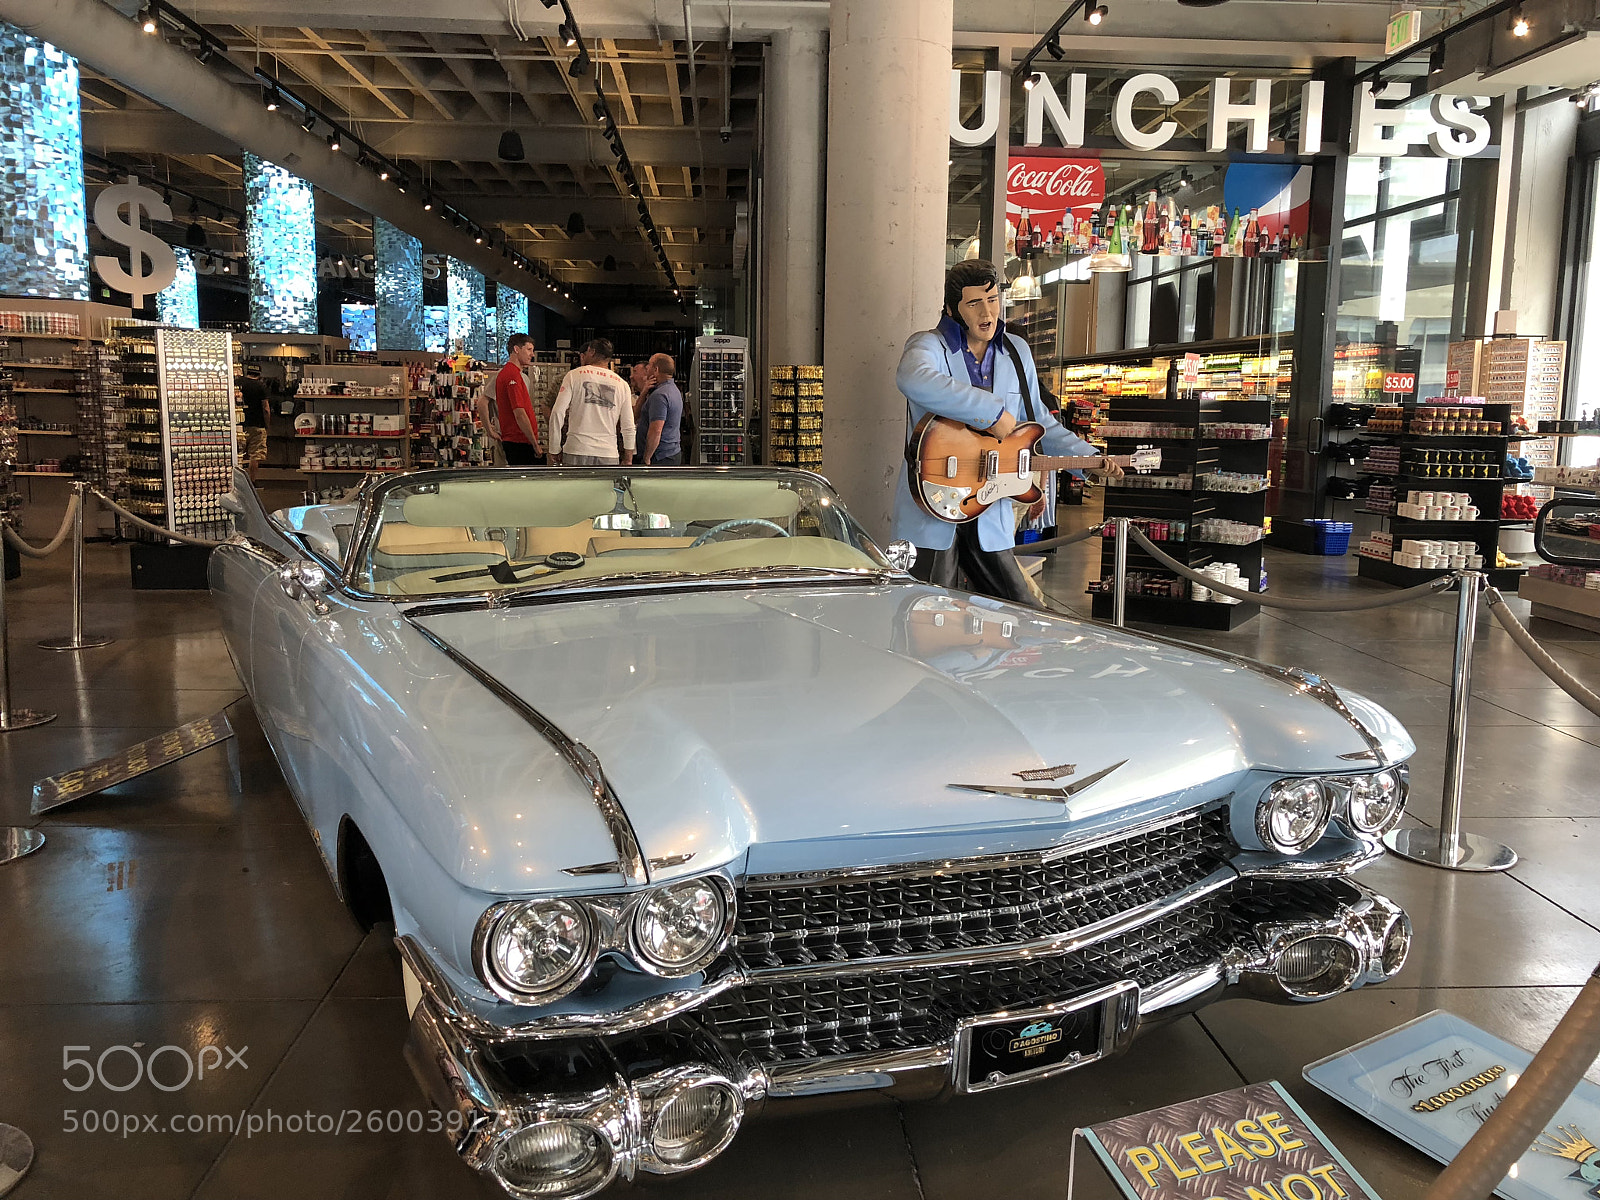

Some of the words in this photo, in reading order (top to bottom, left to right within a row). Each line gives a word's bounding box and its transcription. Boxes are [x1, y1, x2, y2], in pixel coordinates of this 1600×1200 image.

[1390, 14, 1410, 47] EXIT
[1007, 163, 1099, 197] Coca-Cola
[193, 249, 247, 276] CIT
[1385, 375, 1414, 389] $5.00
[1389, 1066, 1430, 1098] The
[1422, 1048, 1474, 1080] First
[1125, 1112, 1308, 1189] PLEASE
